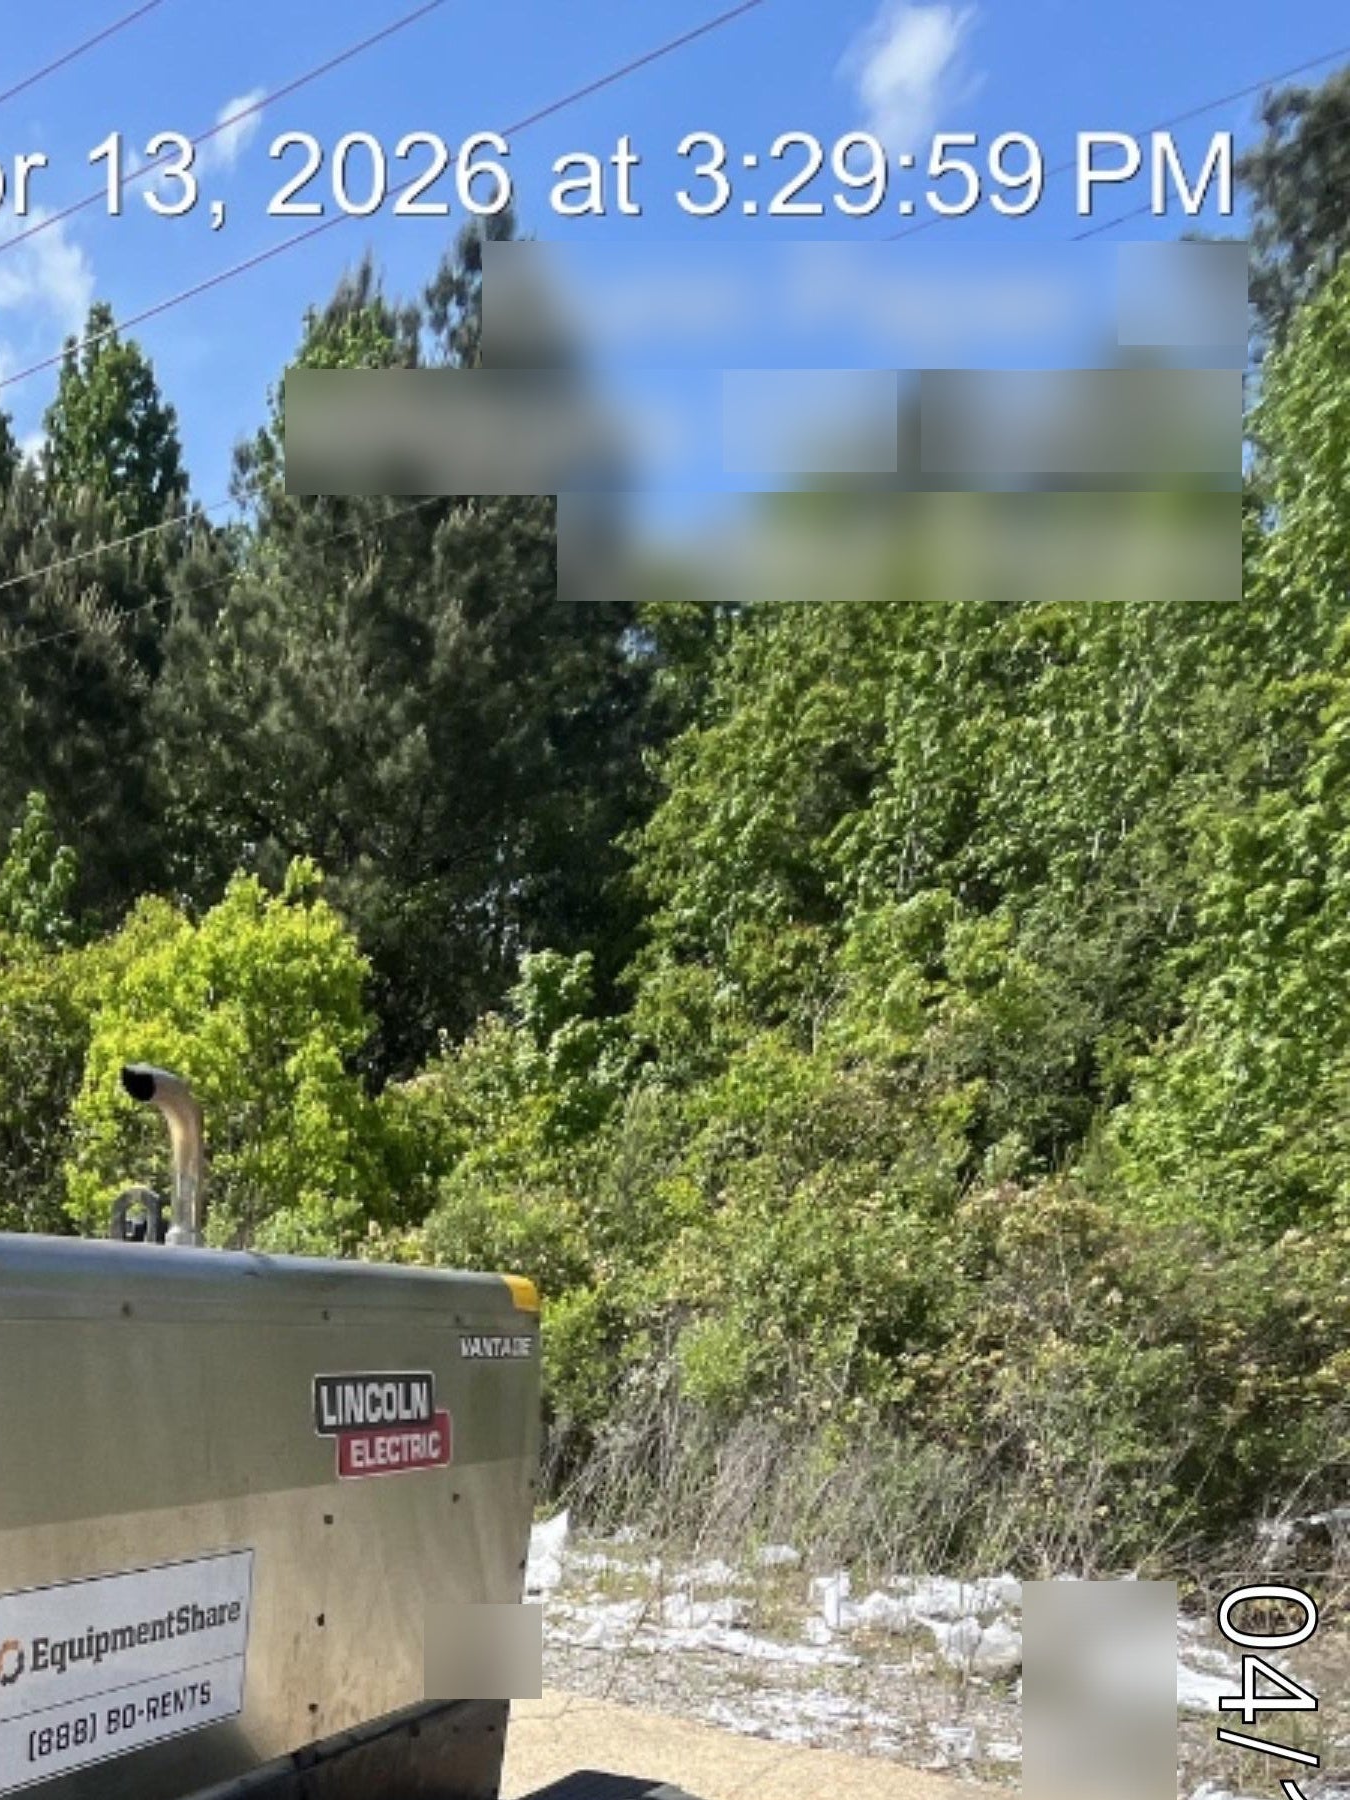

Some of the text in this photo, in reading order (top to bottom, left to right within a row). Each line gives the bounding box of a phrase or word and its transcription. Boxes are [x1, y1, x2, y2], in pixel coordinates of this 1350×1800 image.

[460, 1335, 532, 1358] VANTAGE
[319, 1381, 429, 1427] LINCOLN
[350, 1430, 442, 1469] ELECTRIC
[29, 1599, 242, 1675] EquipmentShare
[28, 1711, 98, 1762] (888)
